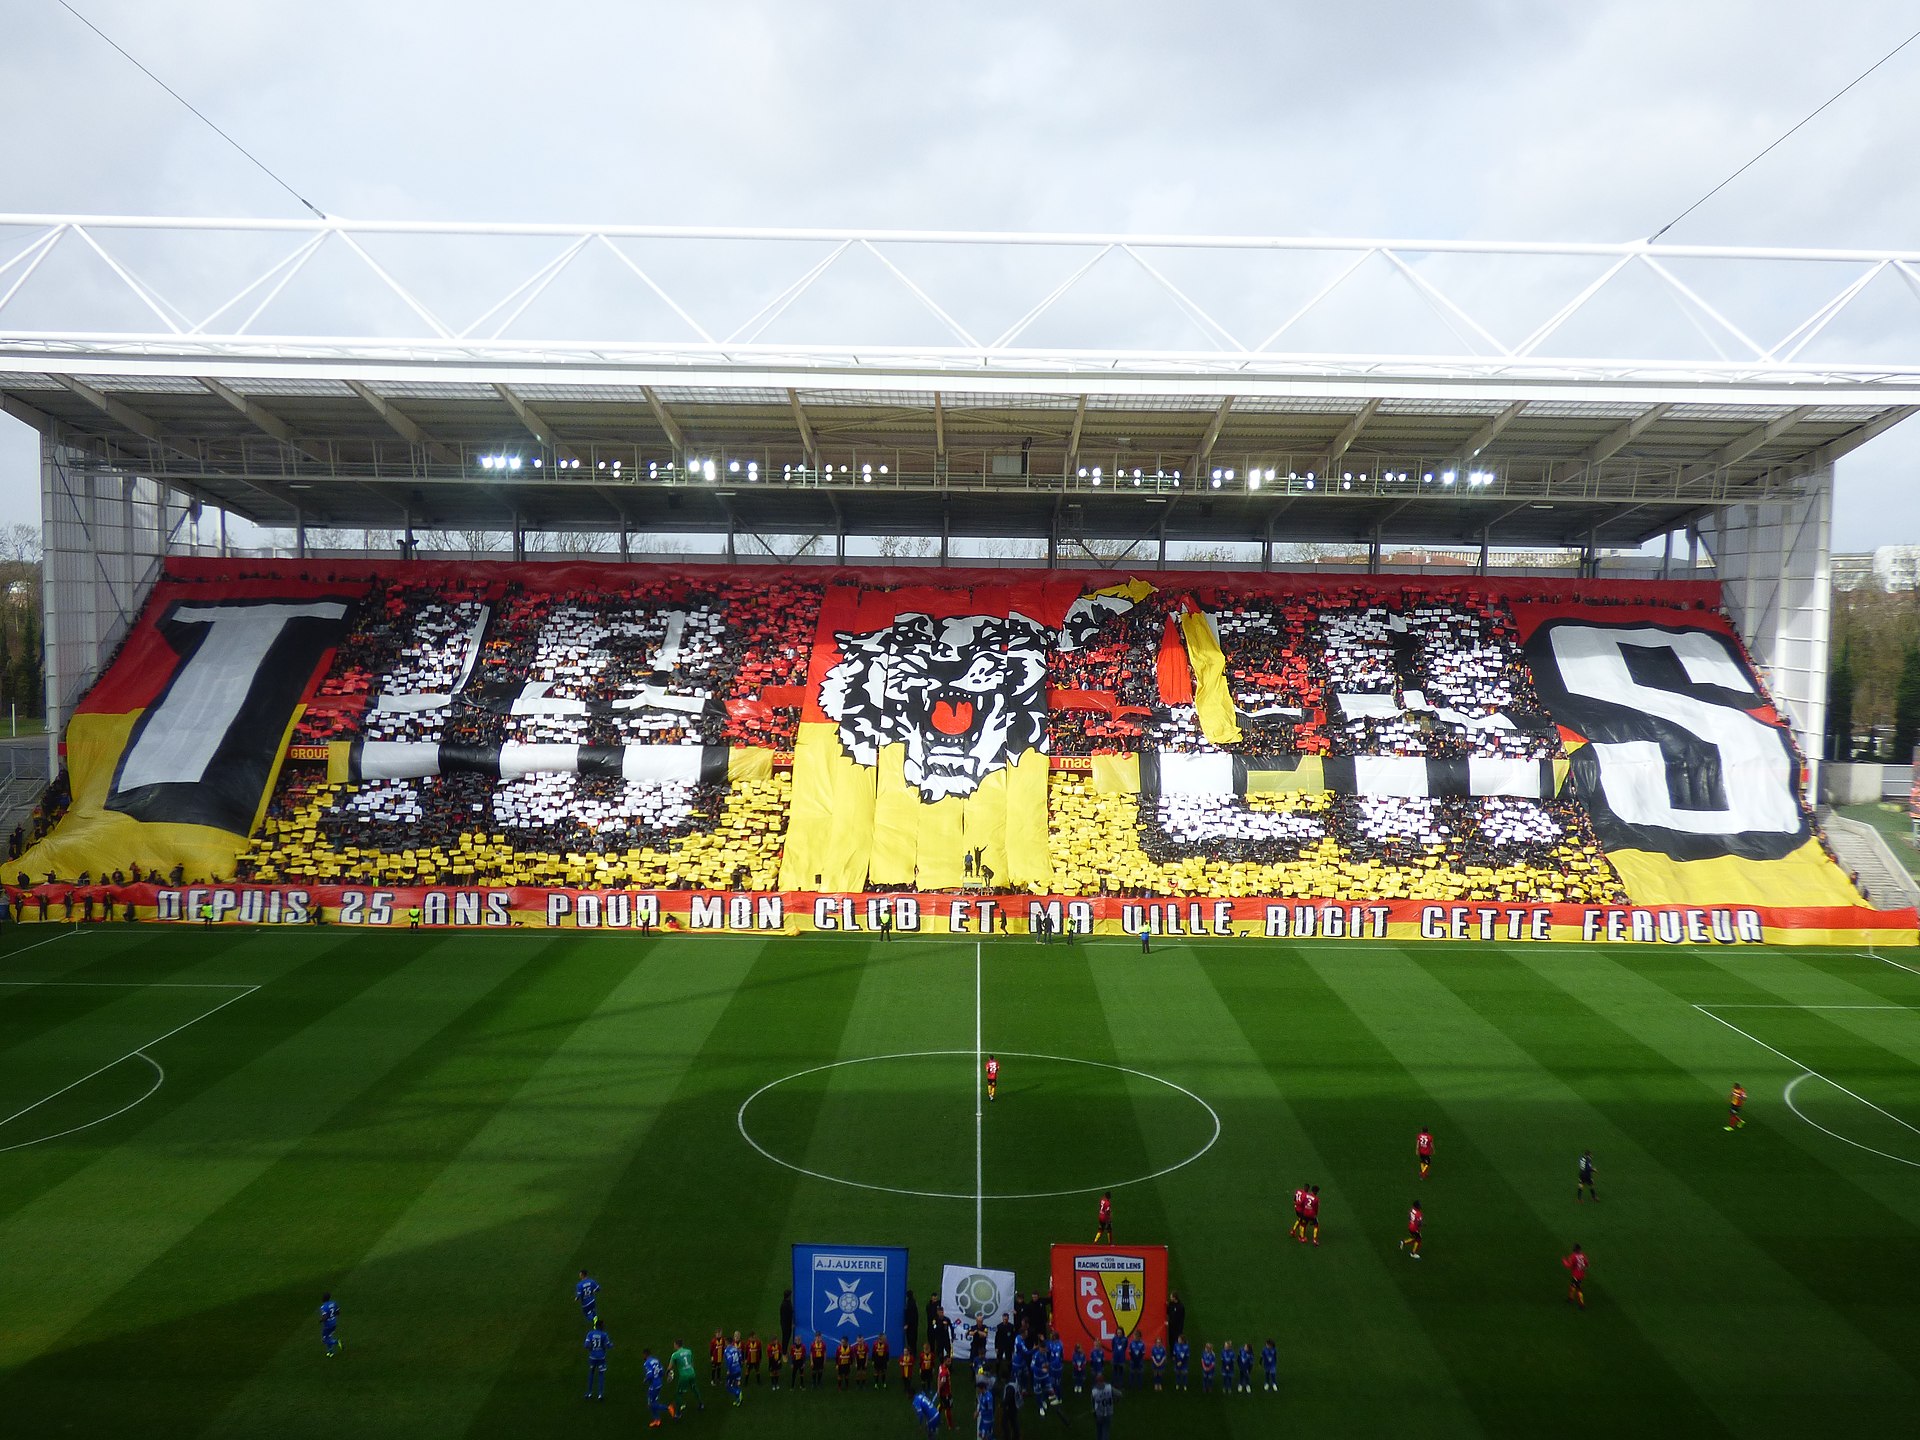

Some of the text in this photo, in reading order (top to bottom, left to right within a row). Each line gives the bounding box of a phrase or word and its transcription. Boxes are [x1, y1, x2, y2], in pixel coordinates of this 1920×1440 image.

[157, 888, 311, 924] DEPUIS
[339, 889, 394, 924] 25
[546, 892, 660, 928] POUR
[690, 894, 785, 930] MON
[813, 896, 921, 932] CLUB
[950, 899, 998, 934] ET
[1029, 900, 1097, 935] MA
[1264, 904, 1391, 938] RUGIT
[1420, 905, 1553, 940] CETTE
[1582, 907, 1764, 944] FERVEUR
[1077, 1261, 1141, 1270] RACING CLUB DE LENS
